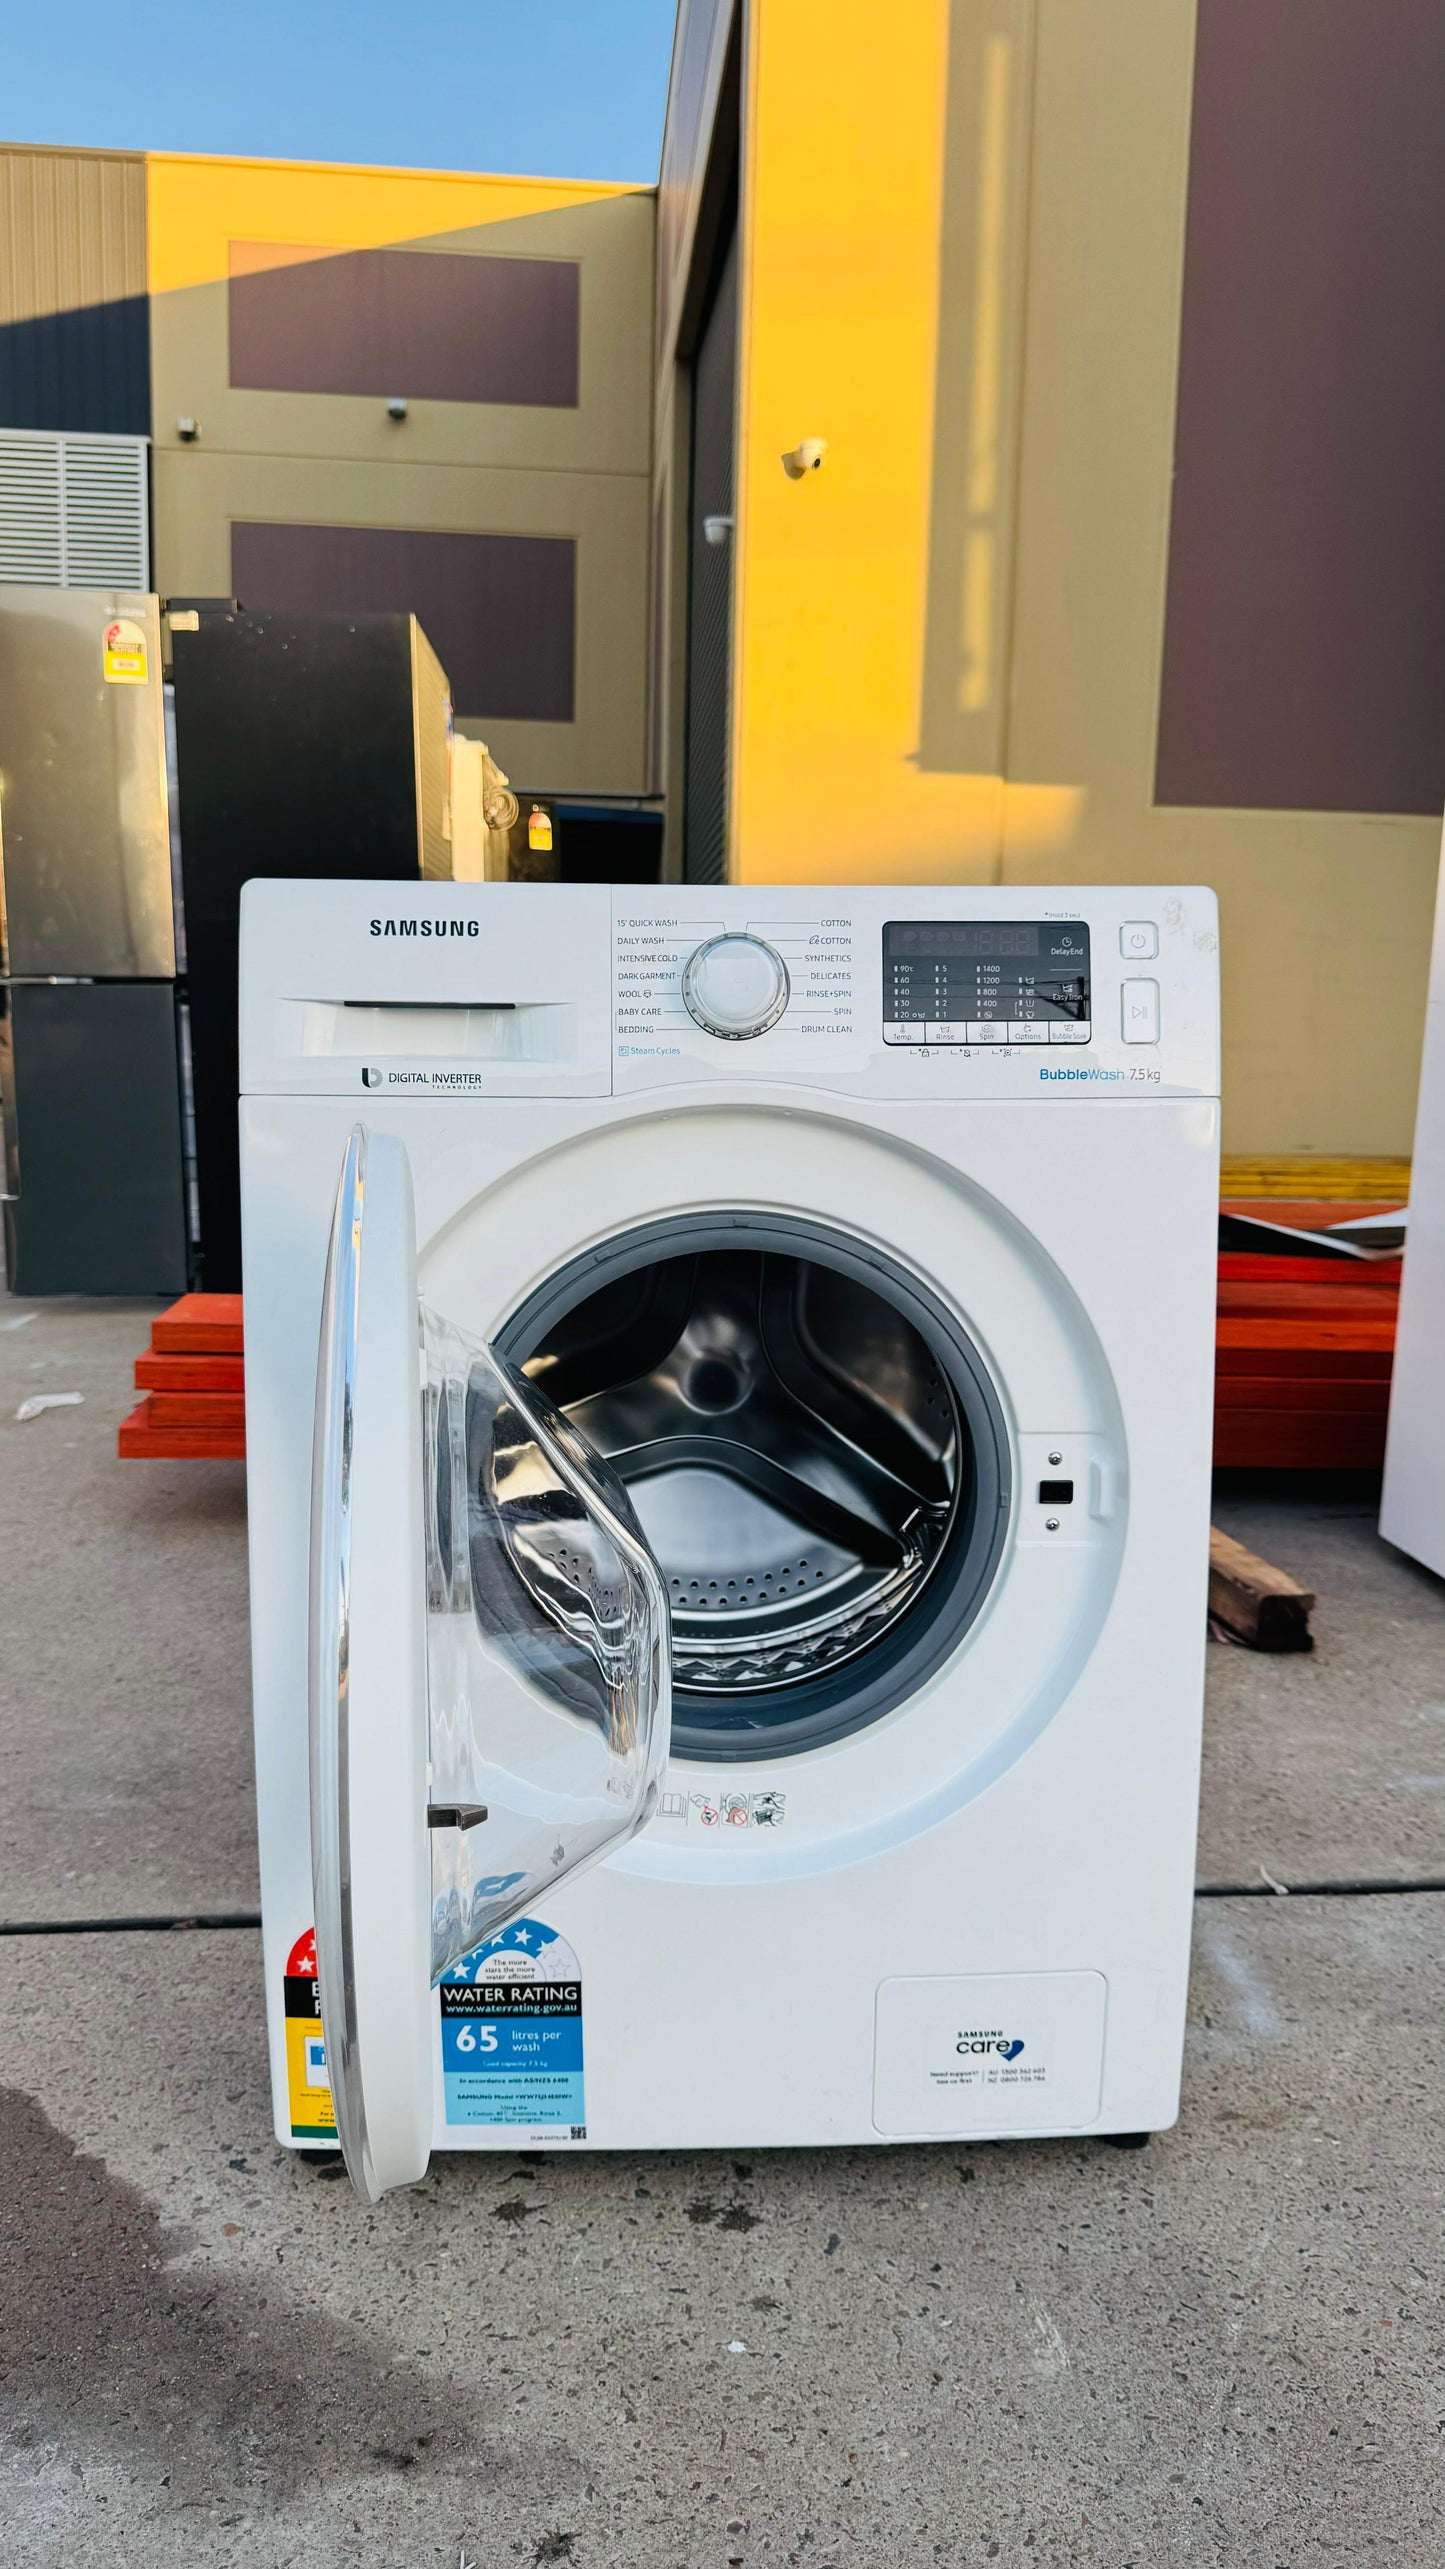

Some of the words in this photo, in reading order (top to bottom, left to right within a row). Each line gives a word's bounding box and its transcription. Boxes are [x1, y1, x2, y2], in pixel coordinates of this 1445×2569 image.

[629, 919, 653, 928] QUICK
[369, 919, 480, 937] SAMSUNG
[617, 937, 640, 945] DAILY
[641, 937, 665, 945] WASH
[820, 937, 852, 945] COTTON
[617, 954, 658, 962] INTENSIVE
[657, 954, 678, 962] COLD
[804, 955, 852, 963] SYNTHETICS
[982, 965, 1001, 973] 1400
[618, 972, 639, 980] DARK
[639, 972, 676, 980] GARMENT
[810, 972, 852, 980] DELICATES
[618, 990, 642, 998] WOOL
[806, 990, 852, 998] RINSE+SPIN
[900, 988, 910, 996] 40
[982, 988, 998, 996] 800
[618, 1008, 640, 1016] BABY
[641, 1008, 662, 1016] CARE
[833, 1008, 853, 1016] SPIN
[618, 1026, 655, 1034] BEDDING
[801, 1025, 825, 1034] DRUM
[827, 1026, 853, 1034] CLEAN
[979, 1034, 995, 1042] Spin
[1014, 1033, 1042, 1041] Options
[631, 1047, 655, 1055] Steam
[656, 1048, 681, 1057] Cycles
[388, 1072, 430, 1083] DIGITAL
[431, 1073, 482, 1084] INVERTER
[443, 1988, 505, 2002] WATER
[511, 1986, 578, 2001] RATING
[445, 2003, 578, 2013] www.waterrating.gov.au
[512, 2030, 539, 2040] litres
[542, 2033, 562, 2043] per
[957, 2030, 1004, 2038] SAMSUNG
[456, 2025, 499, 2052] 65
[512, 2042, 541, 2052] wash
[956, 2040, 1011, 2054] care
